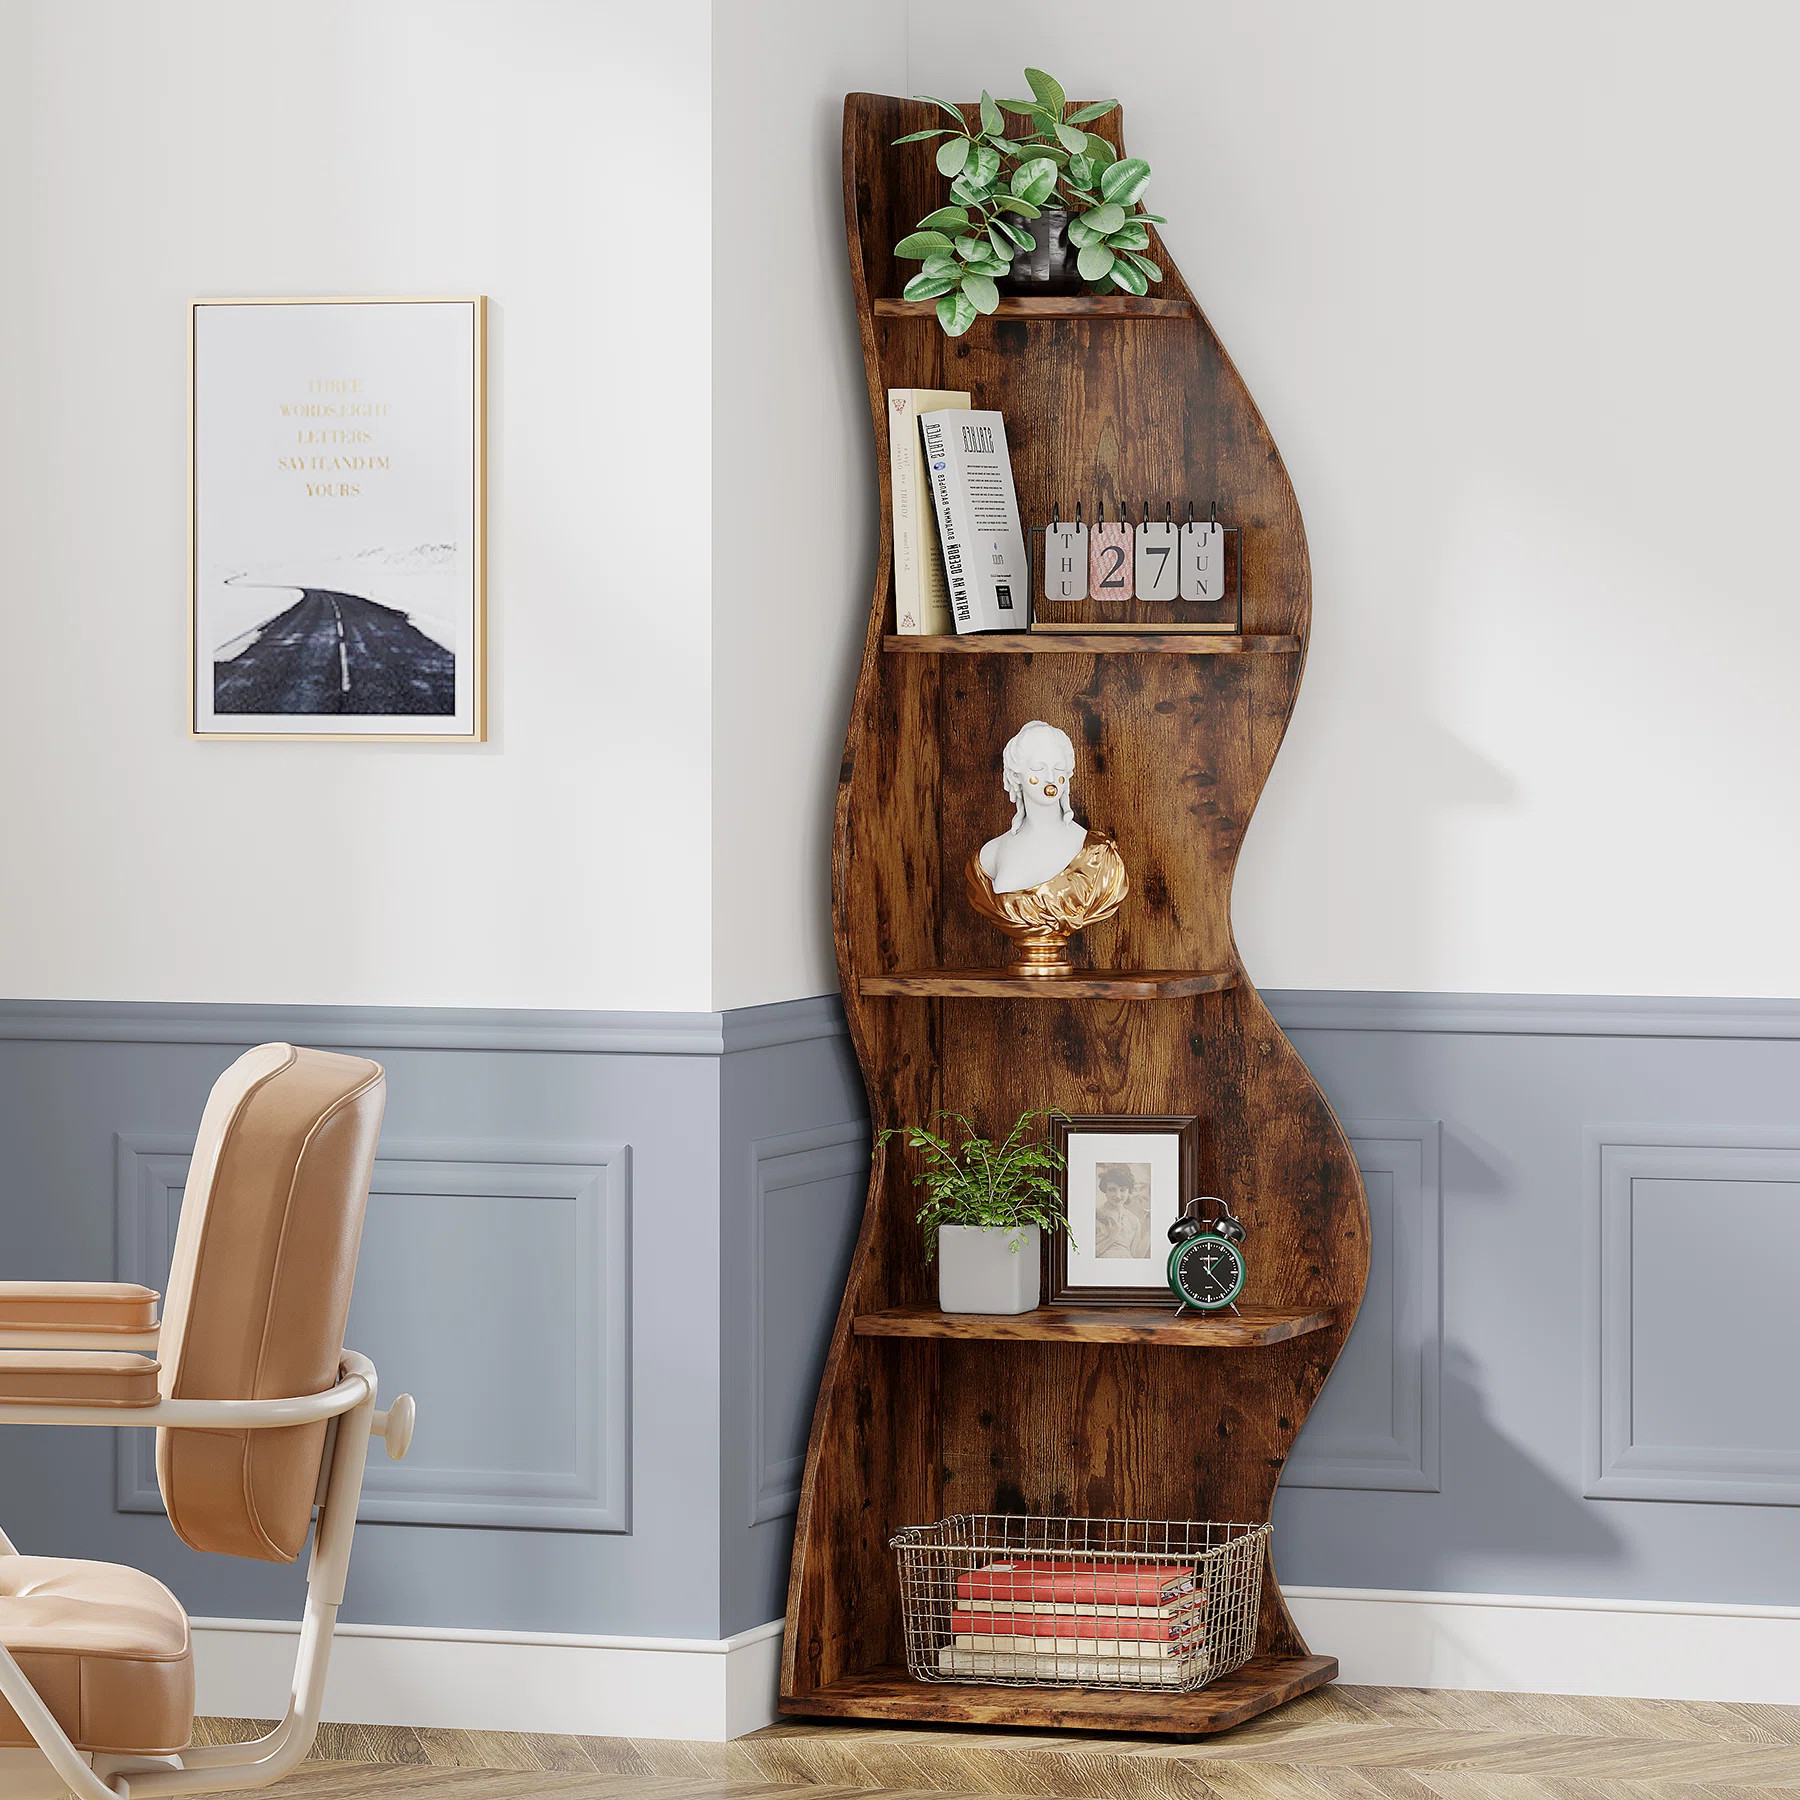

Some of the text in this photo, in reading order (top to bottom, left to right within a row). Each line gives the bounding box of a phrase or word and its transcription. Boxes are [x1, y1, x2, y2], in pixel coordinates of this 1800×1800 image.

[298, 429, 373, 443] LETTERS
[279, 456, 305, 470] SAY
[306, 483, 361, 497] YOURS
[1060, 533, 1073, 596] THU
[1195, 532, 1209, 595] JUN
